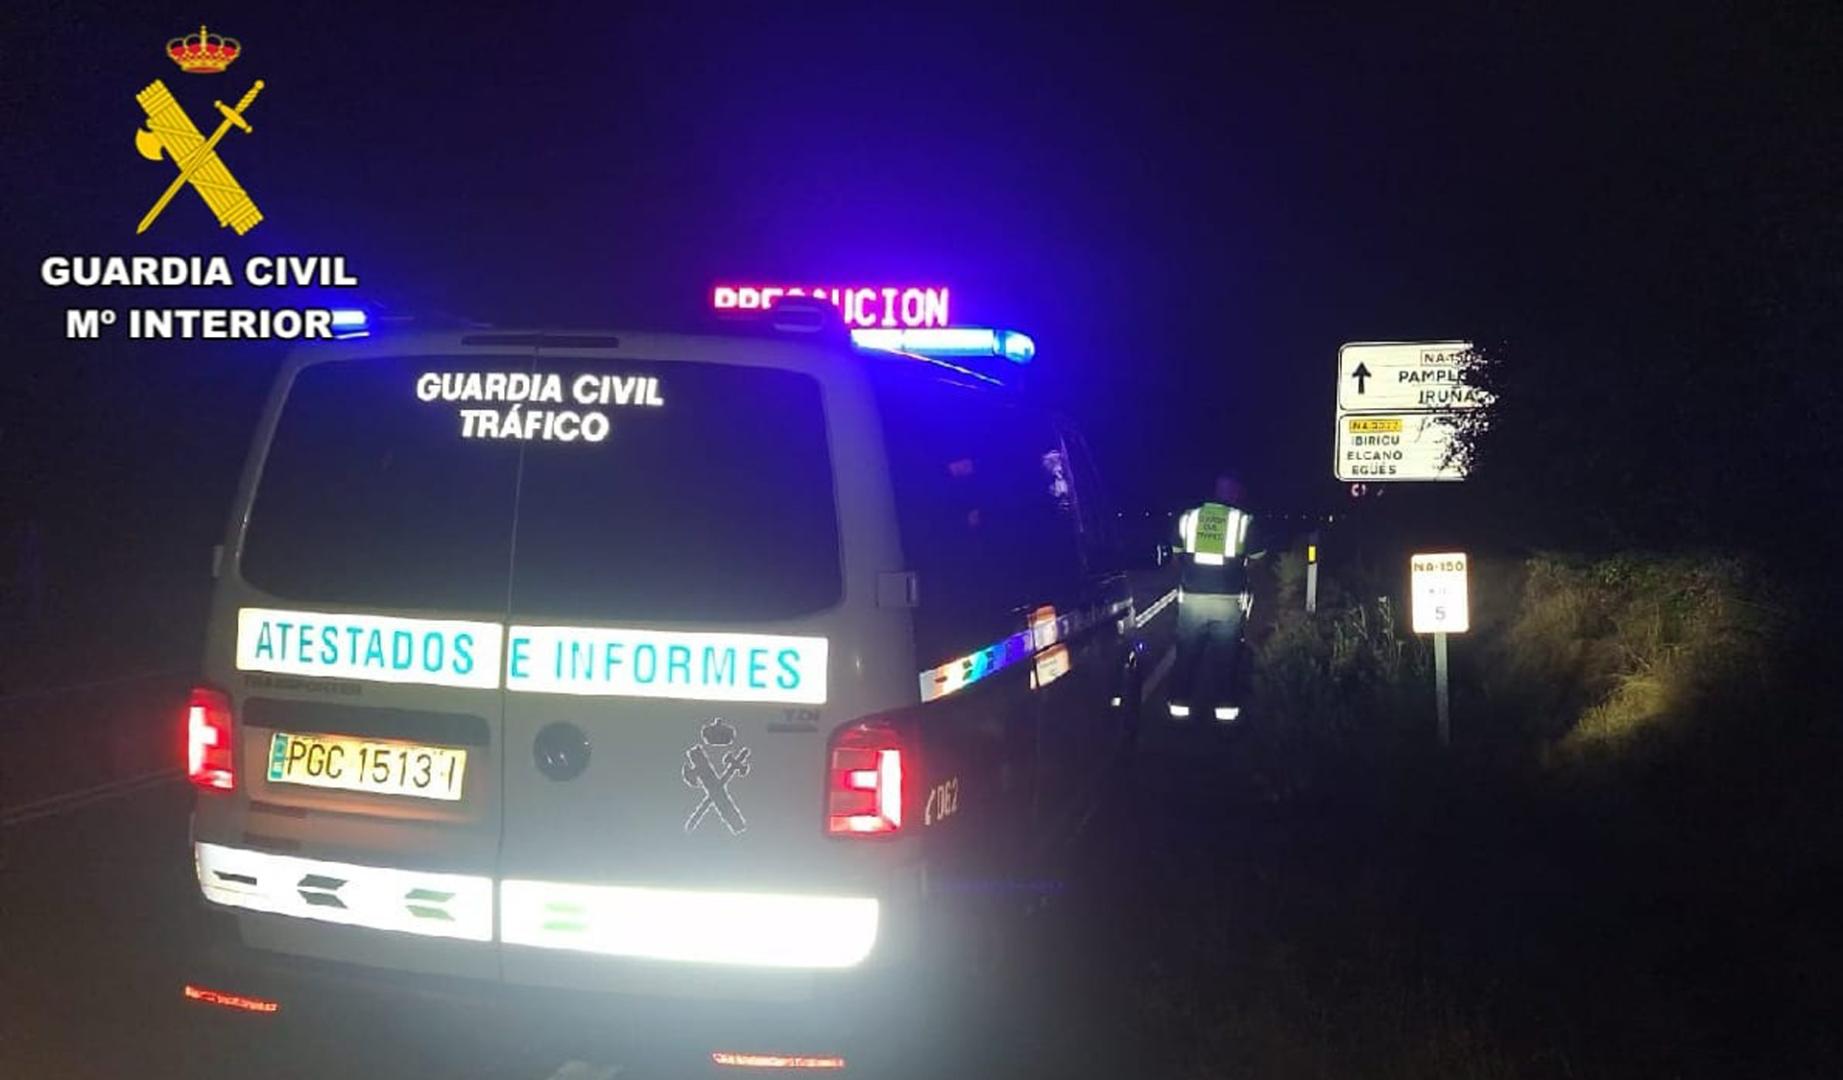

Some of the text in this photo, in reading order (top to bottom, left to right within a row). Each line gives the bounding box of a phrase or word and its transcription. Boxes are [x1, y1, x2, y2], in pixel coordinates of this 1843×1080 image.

[417, 372, 664, 406] GUARDIA CIVIL
[460, 404, 610, 442] TRÁFICO
[1352, 435, 1400, 446] IBIRICU
[1347, 450, 1403, 460] ELCANO
[1414, 561, 1464, 572] NA-150
[1435, 606, 1446, 621] 5
[255, 621, 801, 690] ATESTADOS E INFORMES
[287, 740, 345, 780] PGC
[359, 747, 433, 789] 1513
